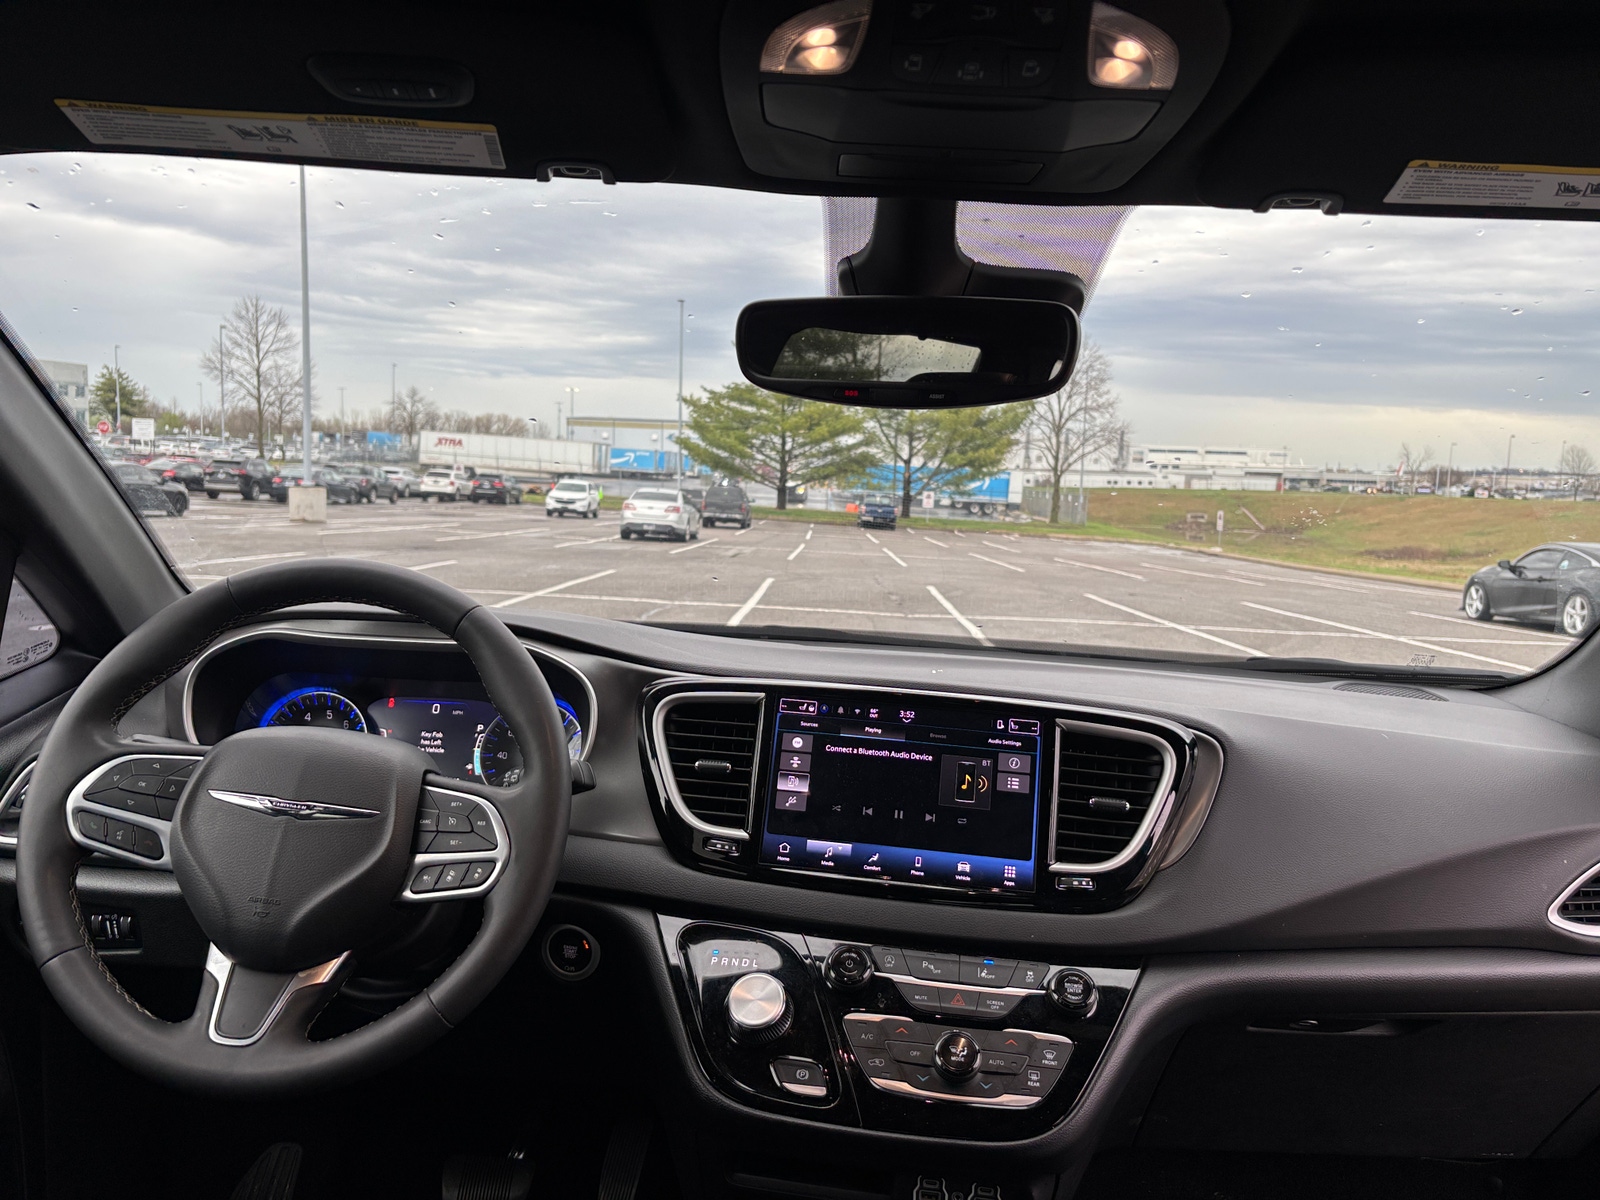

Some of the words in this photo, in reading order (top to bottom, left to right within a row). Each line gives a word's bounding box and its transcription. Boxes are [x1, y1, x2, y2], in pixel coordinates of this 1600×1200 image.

[324, 115, 354, 123] MISE
[378, 118, 418, 126] GARDE
[1438, 162, 1500, 171] WARNING
[844, 389, 859, 397] SOS
[434, 437, 464, 448] XTRA
[432, 703, 440, 714] 0
[304, 712, 311, 721] 4
[326, 709, 333, 719] 5
[899, 710, 915, 719] 3:52
[343, 720, 349, 729] 6
[477, 724, 484, 732] P
[800, 720, 818, 728] Sources
[864, 726, 882, 734] Playing
[1002, 739, 1022, 747] Settings
[497, 751, 508, 760] 40
[825, 744, 852, 754] Connect
[858, 748, 890, 758] Bluetooth
[890, 751, 910, 760] Audio
[910, 752, 933, 762] Device
[247, 896, 281, 906] AIRBAG
[711, 956, 718, 965] P
[721, 957, 729, 966] R
[731, 958, 740, 966] N
[742, 958, 750, 967] D
[753, 959, 758, 968] L
[922, 961, 928, 969] P
